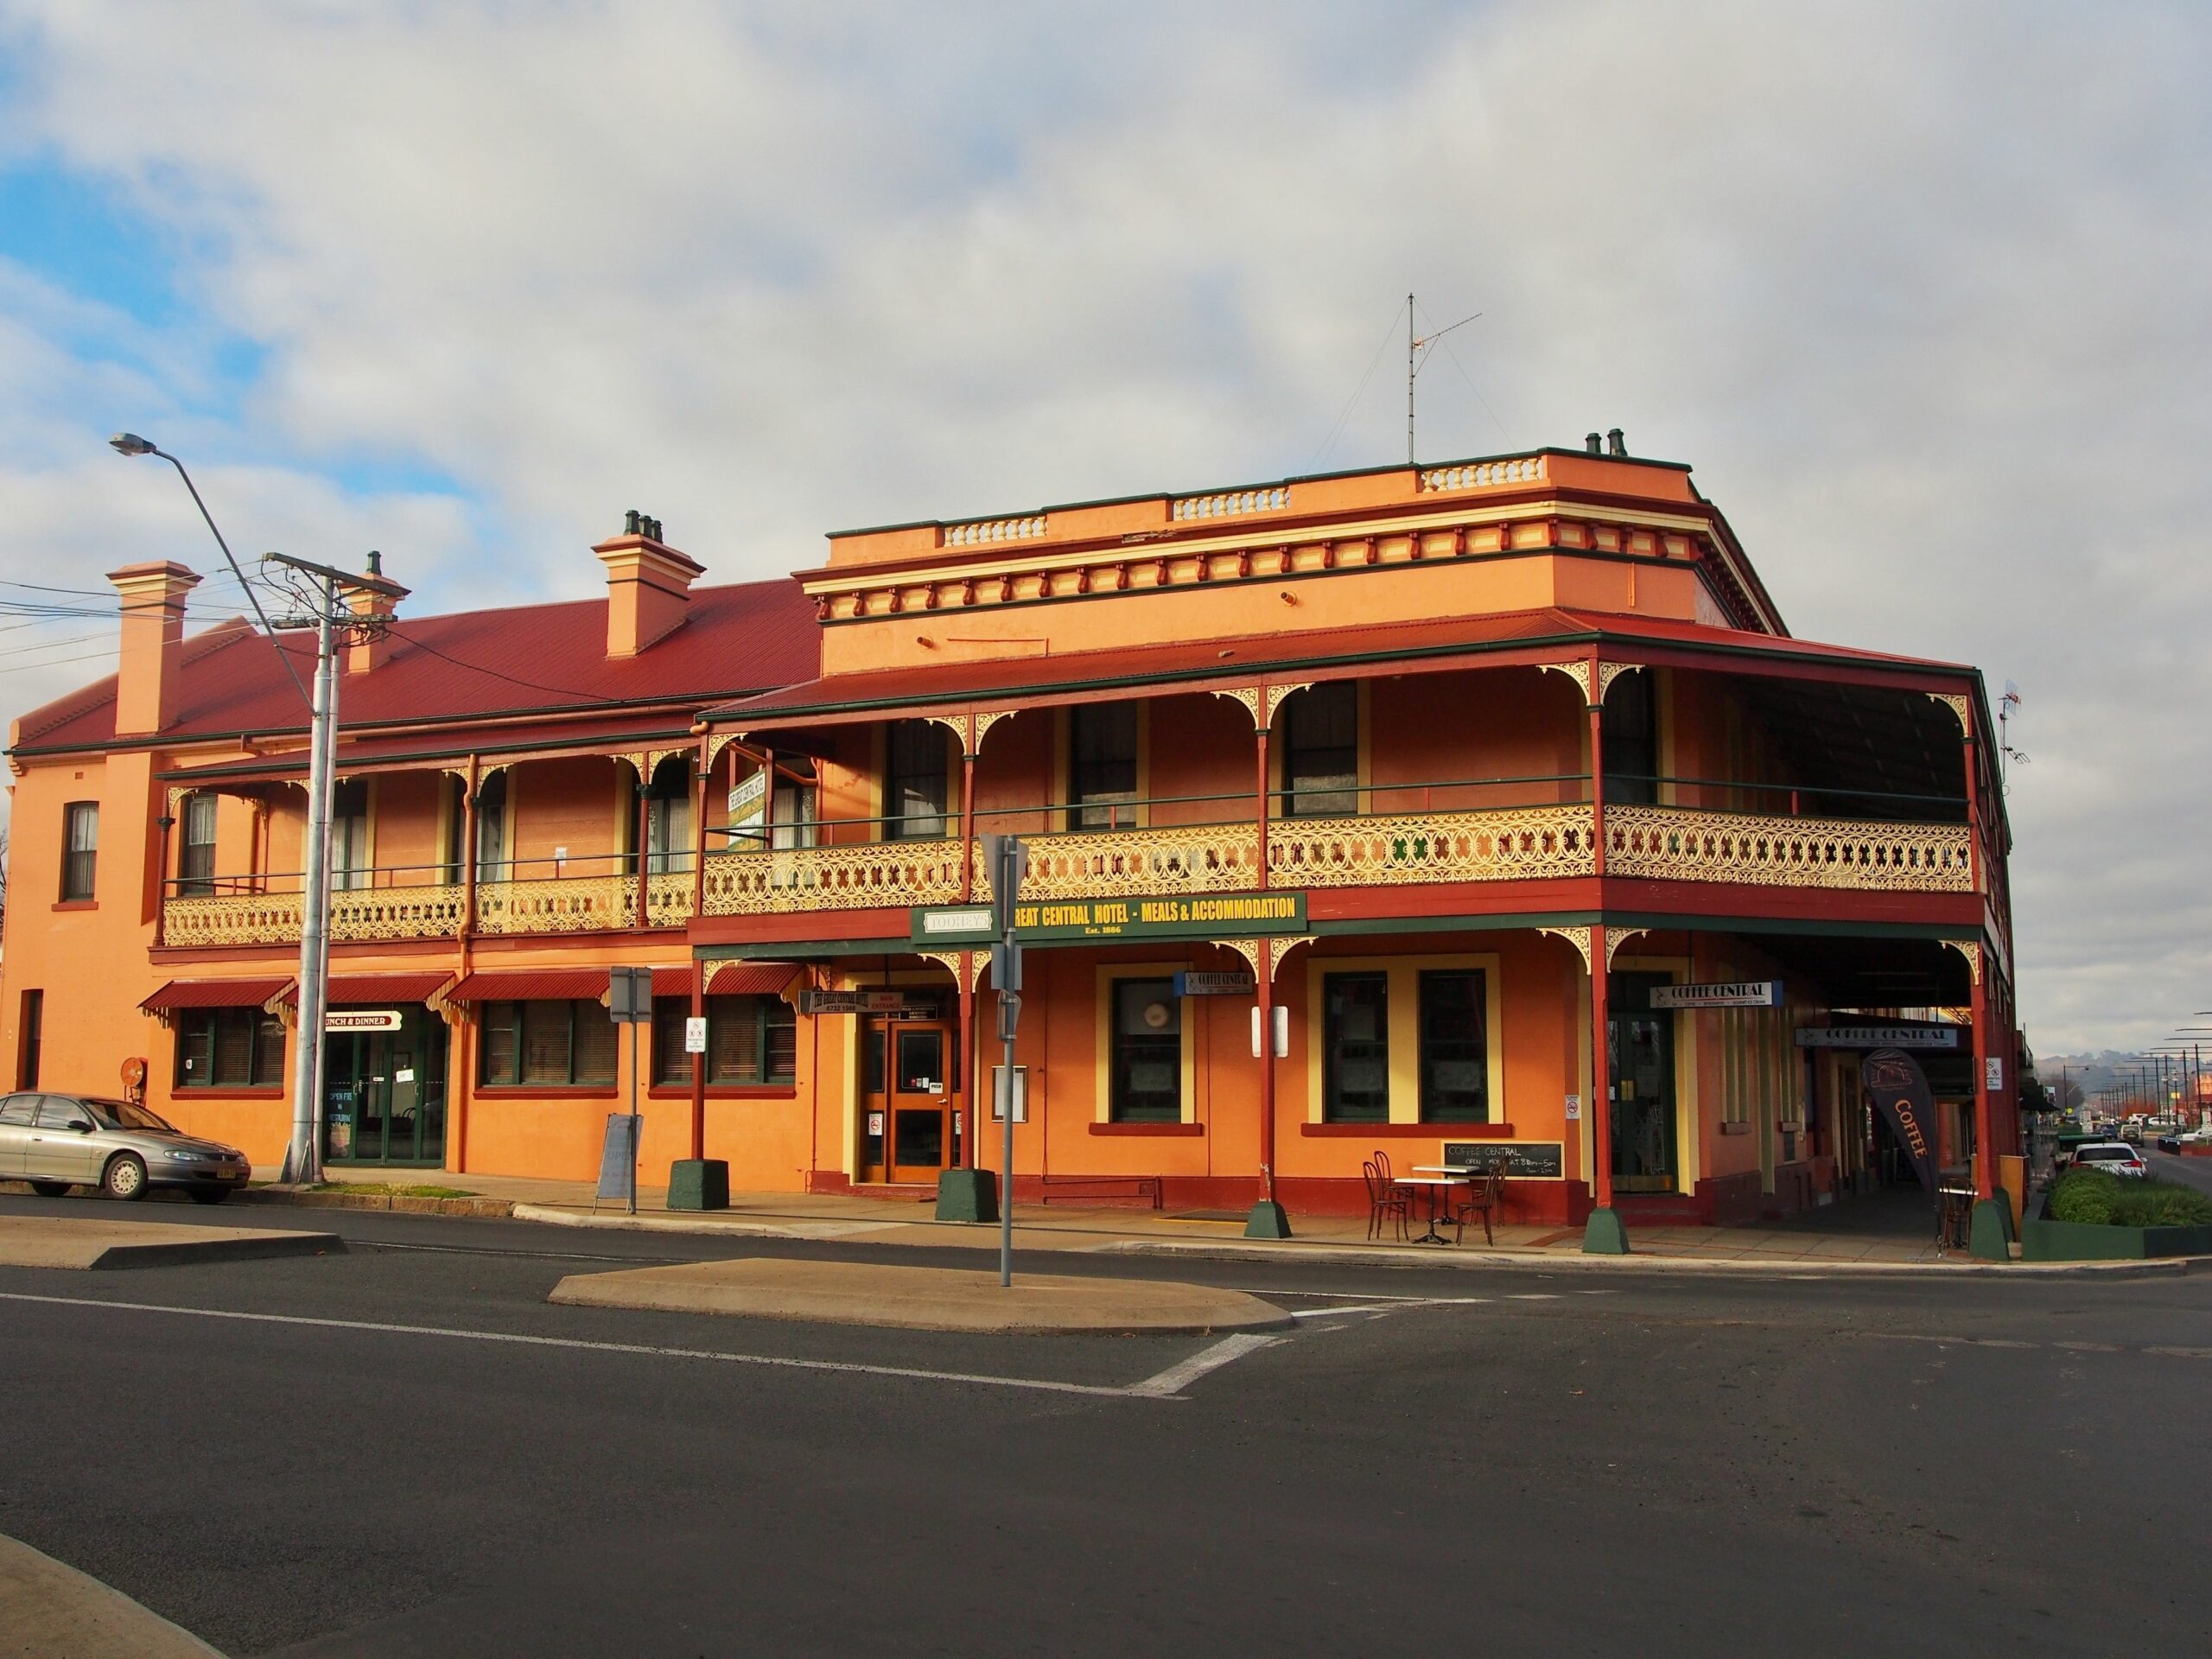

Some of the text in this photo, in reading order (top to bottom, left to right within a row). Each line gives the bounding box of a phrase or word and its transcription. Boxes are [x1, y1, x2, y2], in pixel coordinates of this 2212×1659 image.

[1014, 907, 1039, 927] REAT
[1042, 905, 1090, 926] CENTRAL
[1094, 903, 1129, 924] HOTEL
[1141, 901, 1179, 922] MEALS
[1180, 905, 1190, 921] &
[1192, 898, 1296, 920] ACCOMMODATION
[1103, 925, 1122, 934] 1886
[1671, 983, 1766, 998] COFFEE CENTRAL
[325, 1018, 346, 1027] UNCH
[354, 1017, 385, 1026] DINNER
[1895, 1099, 1928, 1160] COFFEE
[1448, 1146, 1522, 1156] COFFEE CENTRAL
